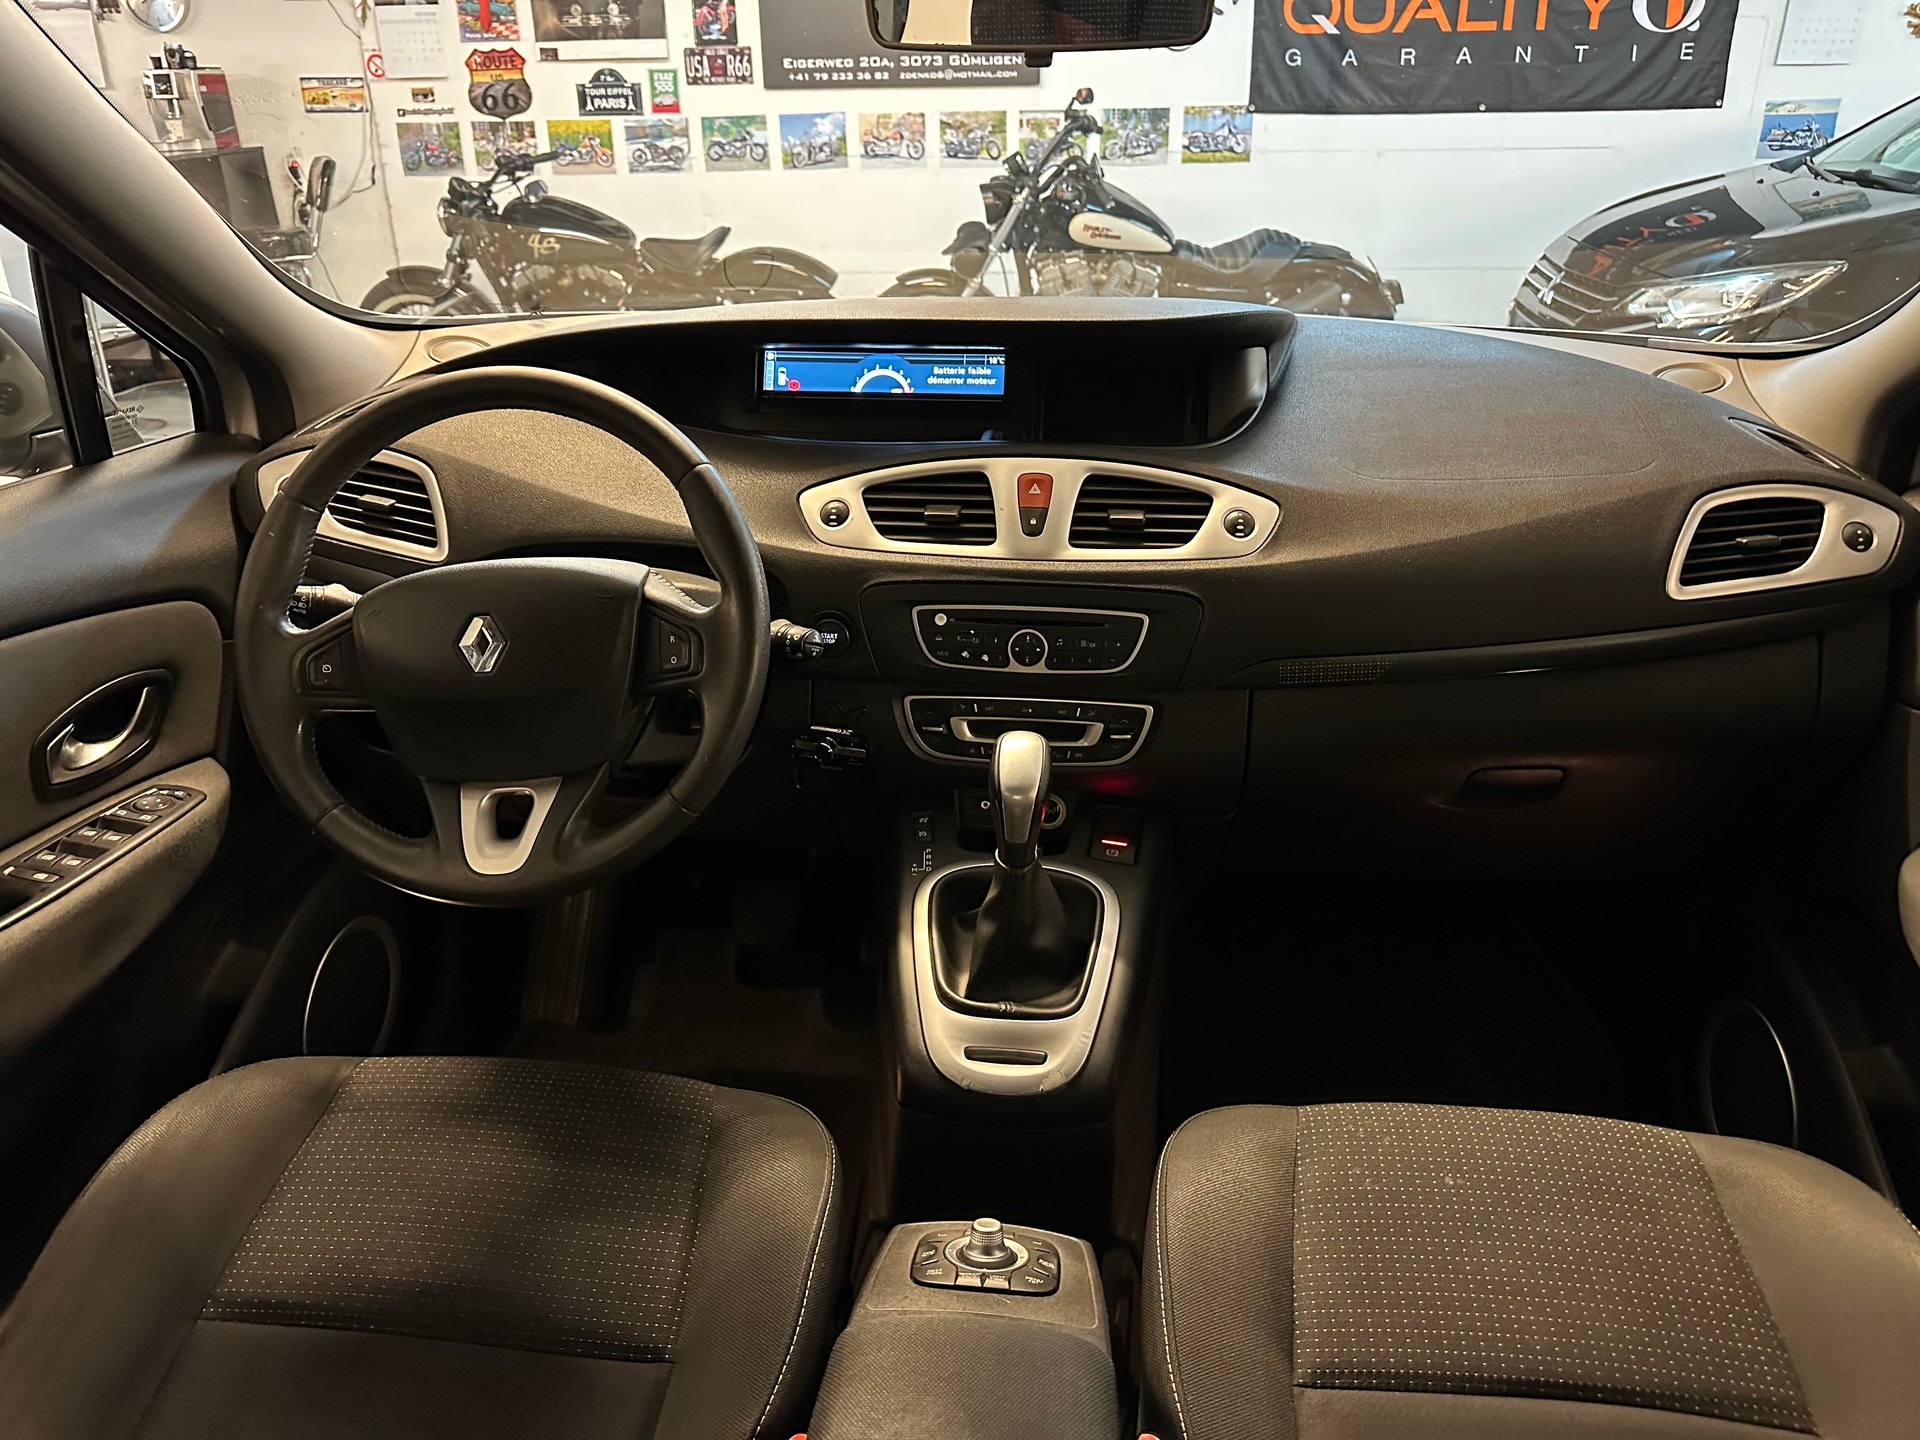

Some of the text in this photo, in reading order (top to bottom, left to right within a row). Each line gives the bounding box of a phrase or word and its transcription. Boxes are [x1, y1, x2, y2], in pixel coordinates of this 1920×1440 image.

[1283, 0, 1610, 34] QUALITY
[1284, 42, 1695, 67] GARANTIE
[474, 54, 518, 70] ROUTE
[685, 54, 751, 78] USA R66
[899, 55, 944, 67] 3073
[652, 72, 675, 81] FIAT
[813, 72, 829, 80] 79
[831, 71, 854, 81] 233
[584, 87, 634, 96] TOUR EIFFEL
[652, 82, 675, 94] 500
[482, 82, 520, 111] 66
[593, 97, 627, 109] PARIS
[933, 366, 992, 375] Batterie faible
[927, 376, 997, 385] démarrer moteur
[820, 632, 839, 640] START
